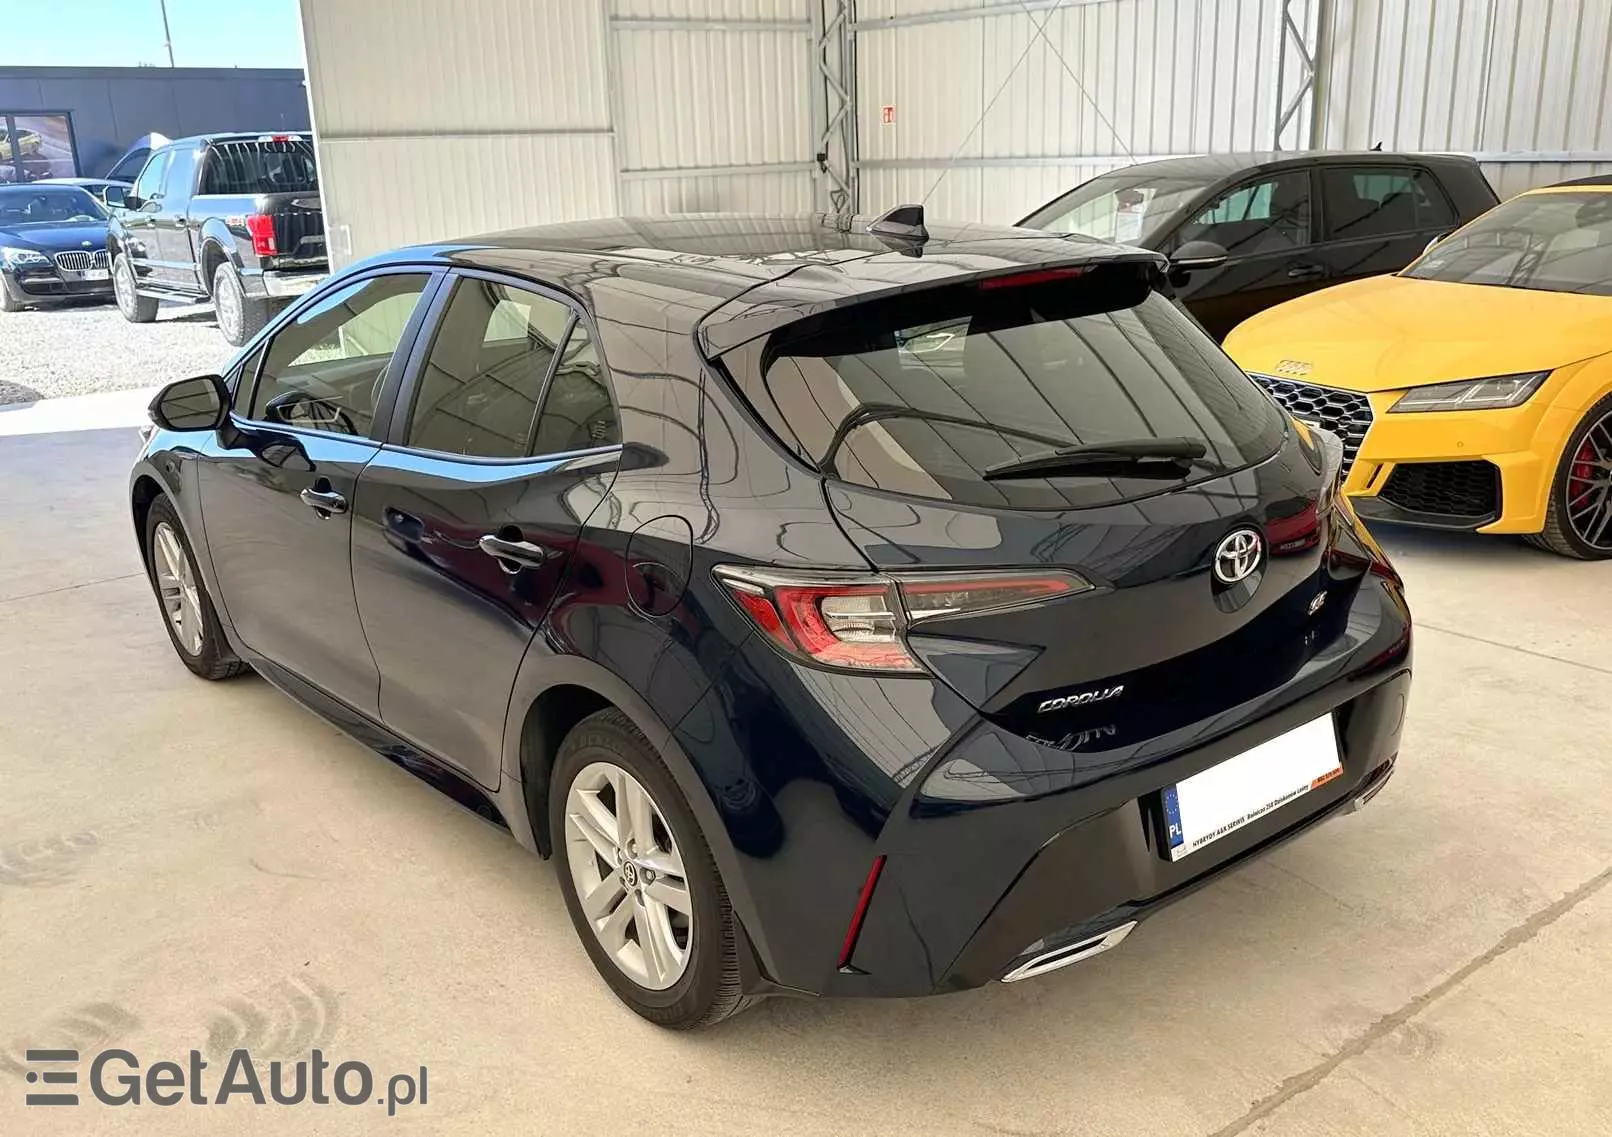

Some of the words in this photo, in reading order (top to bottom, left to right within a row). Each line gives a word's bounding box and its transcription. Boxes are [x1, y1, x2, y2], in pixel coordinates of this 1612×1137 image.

[1037, 685, 1125, 713] COROLLA
[1169, 822, 1182, 839] PL
[1227, 816, 1245, 831] SERWIS
